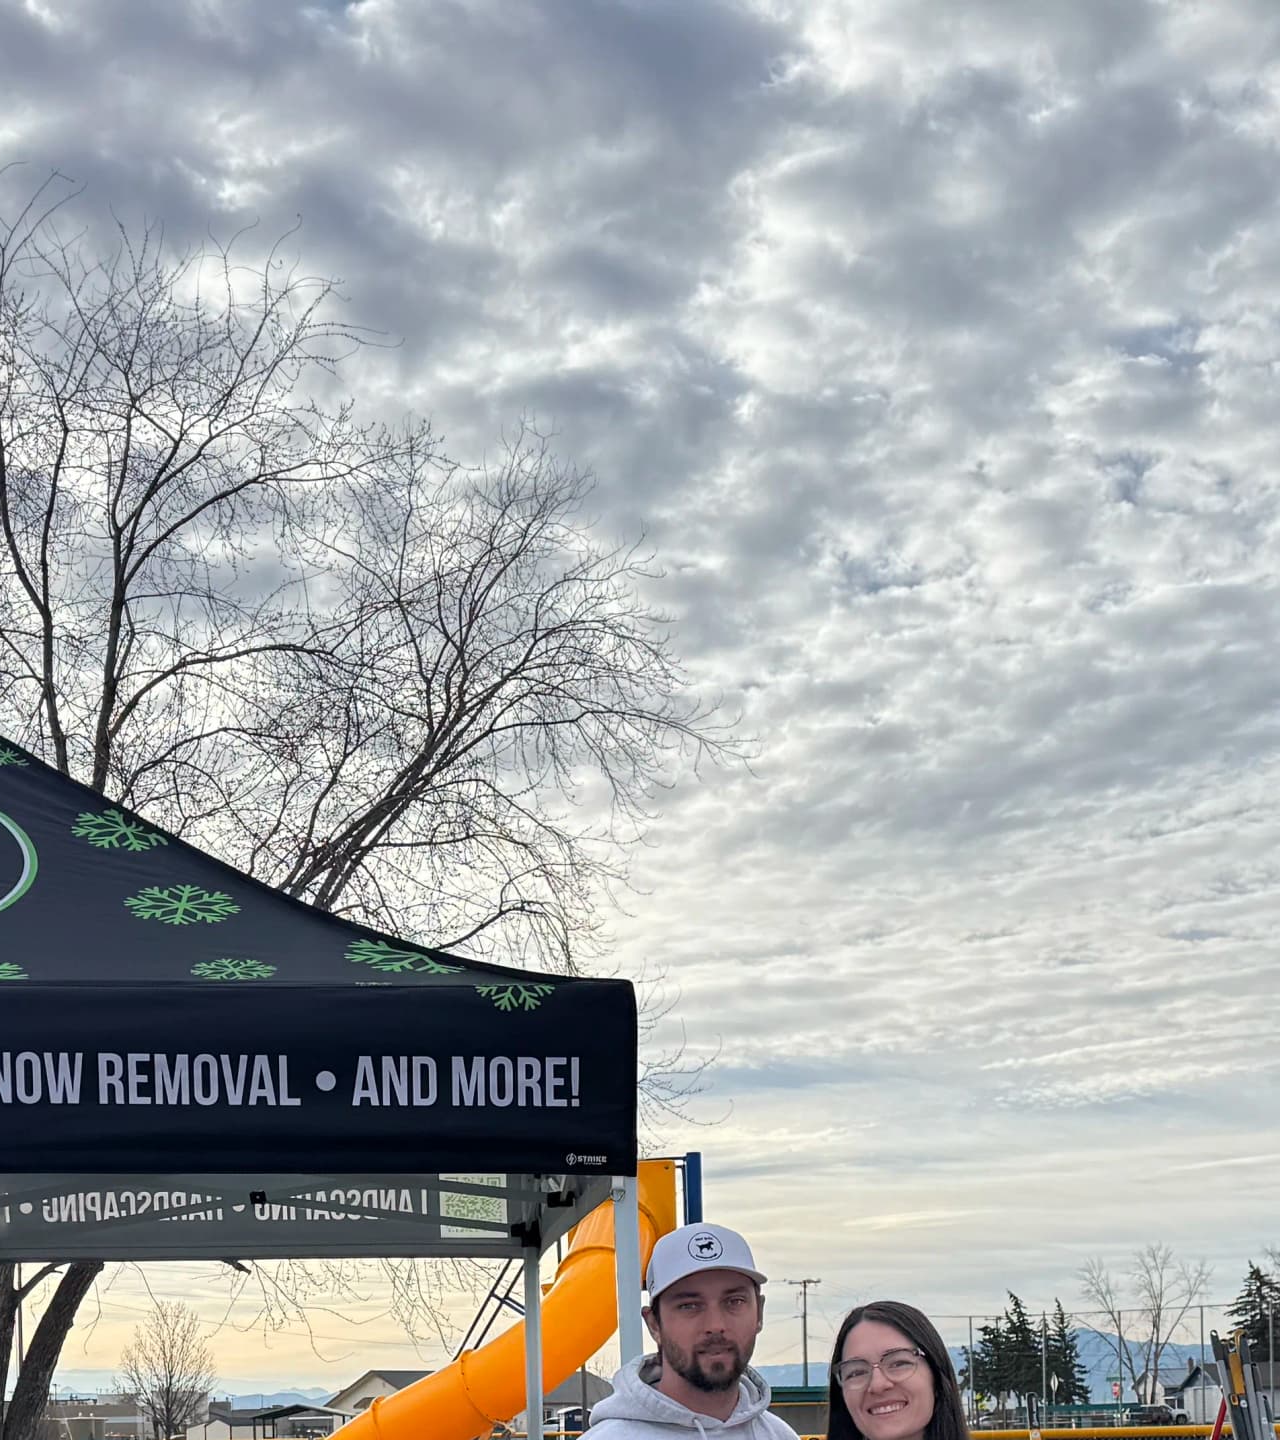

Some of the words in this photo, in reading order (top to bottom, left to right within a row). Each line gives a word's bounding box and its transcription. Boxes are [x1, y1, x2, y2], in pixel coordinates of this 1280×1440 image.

[97, 1052, 302, 1106] REMOVAL
[351, 1055, 438, 1107] AND
[451, 1056, 581, 1107] MORE!
